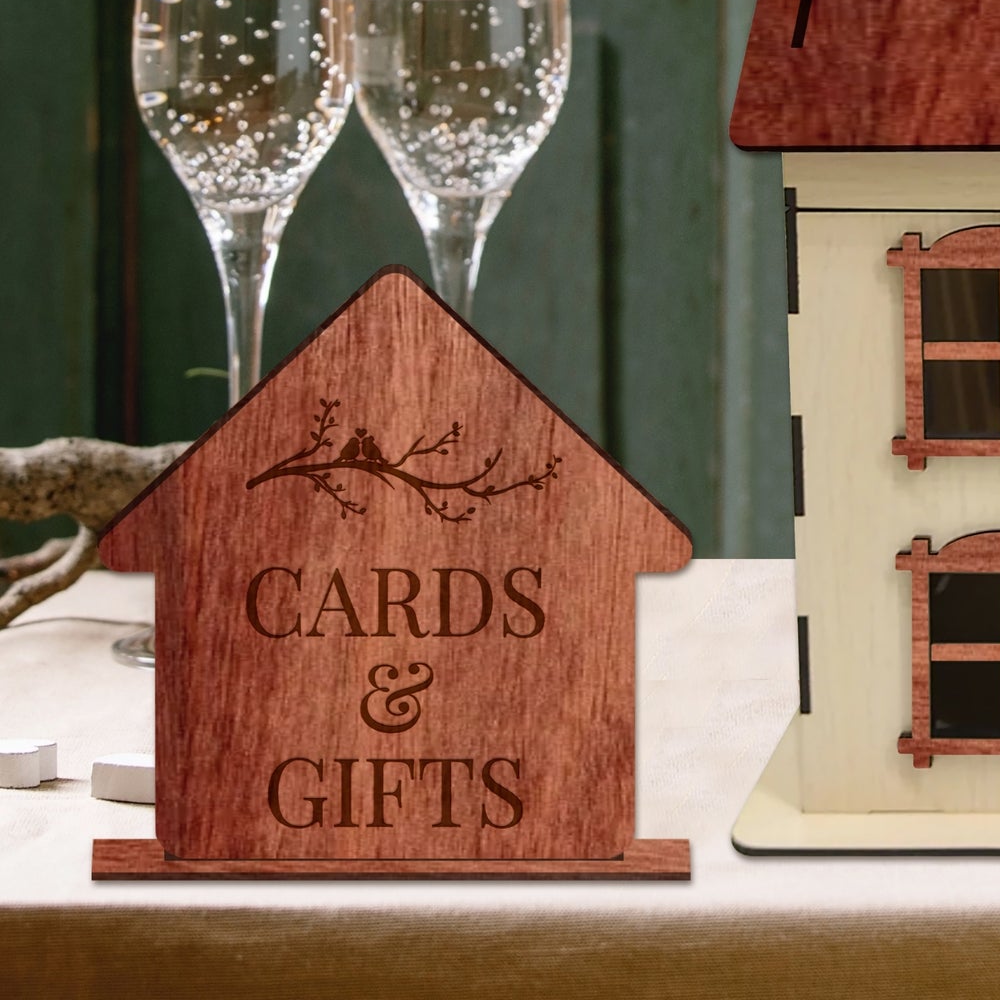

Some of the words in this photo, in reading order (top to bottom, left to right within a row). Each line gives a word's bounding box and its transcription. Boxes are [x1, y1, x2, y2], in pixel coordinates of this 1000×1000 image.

[246, 566, 546, 639] CARDS
[360, 662, 434, 734] &
[267, 757, 524, 829] GIFTS
